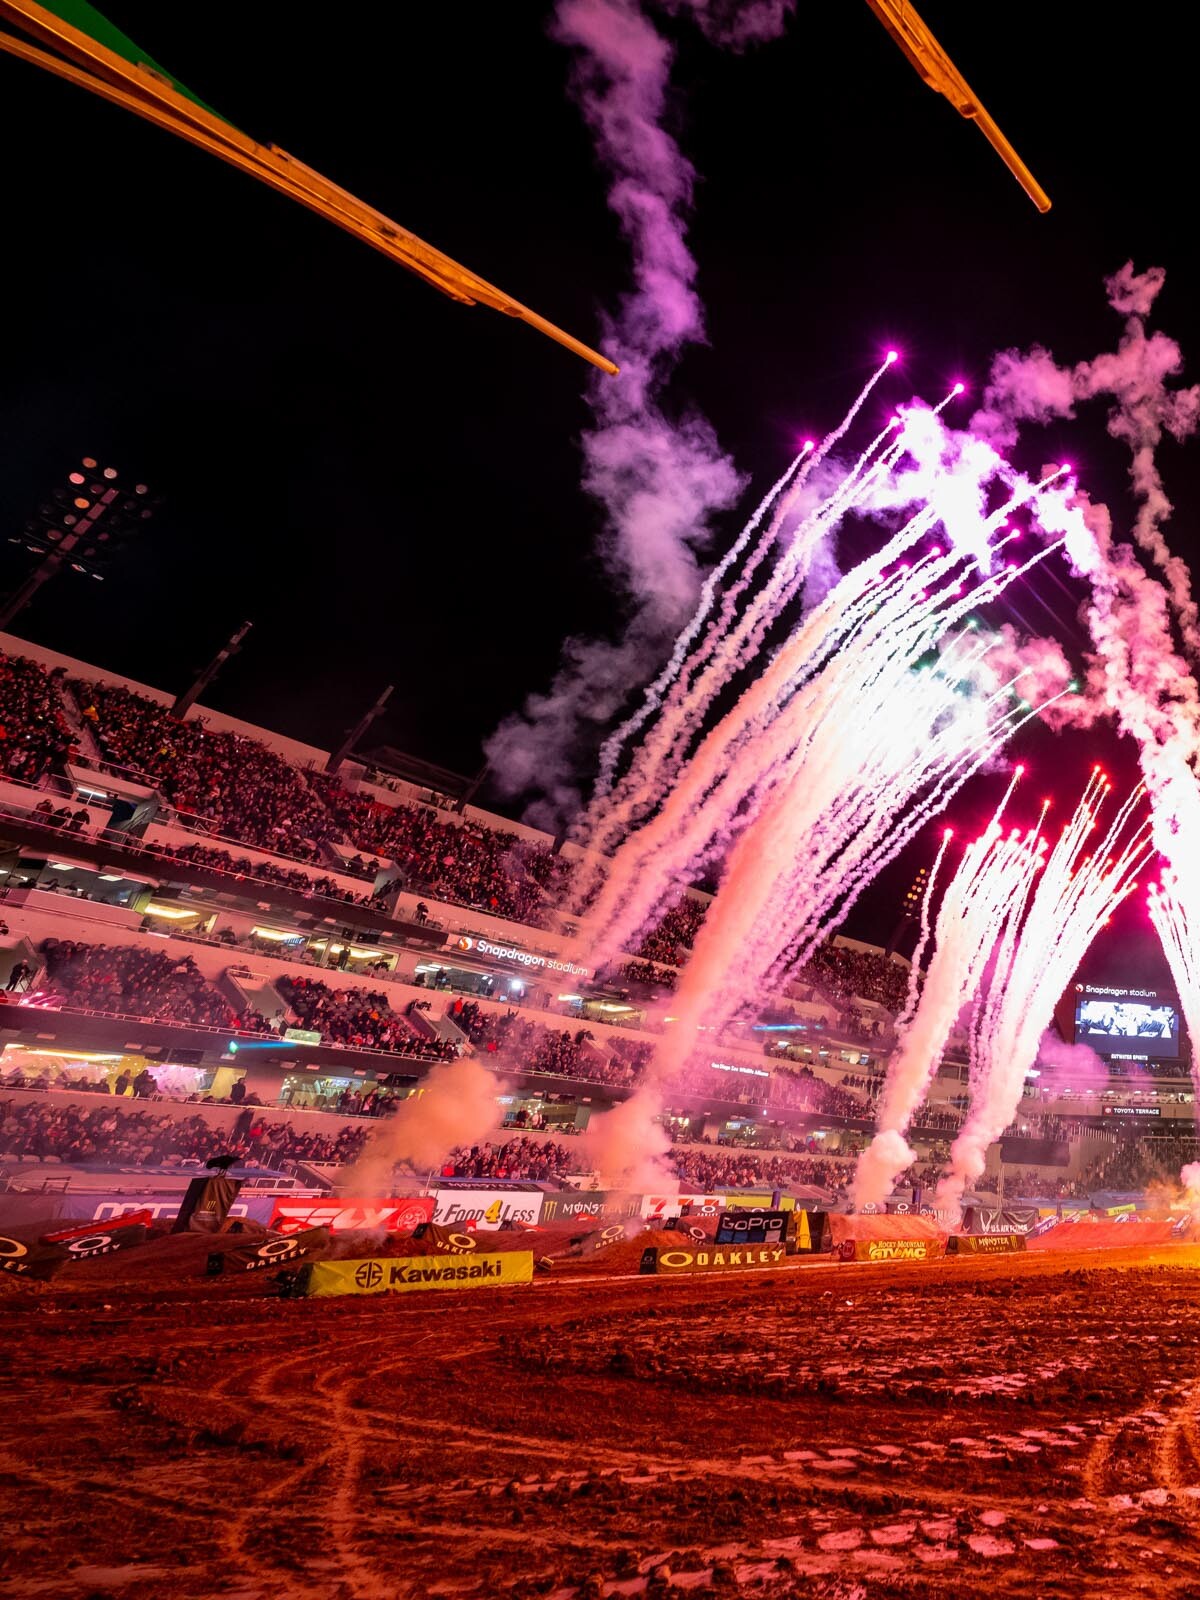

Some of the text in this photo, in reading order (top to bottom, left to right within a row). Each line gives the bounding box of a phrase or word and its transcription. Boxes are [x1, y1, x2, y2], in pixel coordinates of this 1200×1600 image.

[477, 940, 588, 976] Snapdragon stadium
[1085, 985, 1157, 997] Snapdragon stadium
[1113, 1107, 1134, 1115] TOYOTA
[485, 1199, 503, 1224] 4
[563, 1202, 622, 1216] MONST
[722, 1216, 784, 1231] GoPro
[436, 1241, 476, 1256] OAKLE
[596, 1233, 624, 1249] OAKLE
[878, 1240, 926, 1248] ROCKY MOUNTAIN
[978, 1236, 1009, 1246] MONSTER
[246, 1247, 307, 1270] OAKLEY
[697, 1249, 783, 1266] OAKLEY
[389, 1260, 502, 1285] Kawasaki
